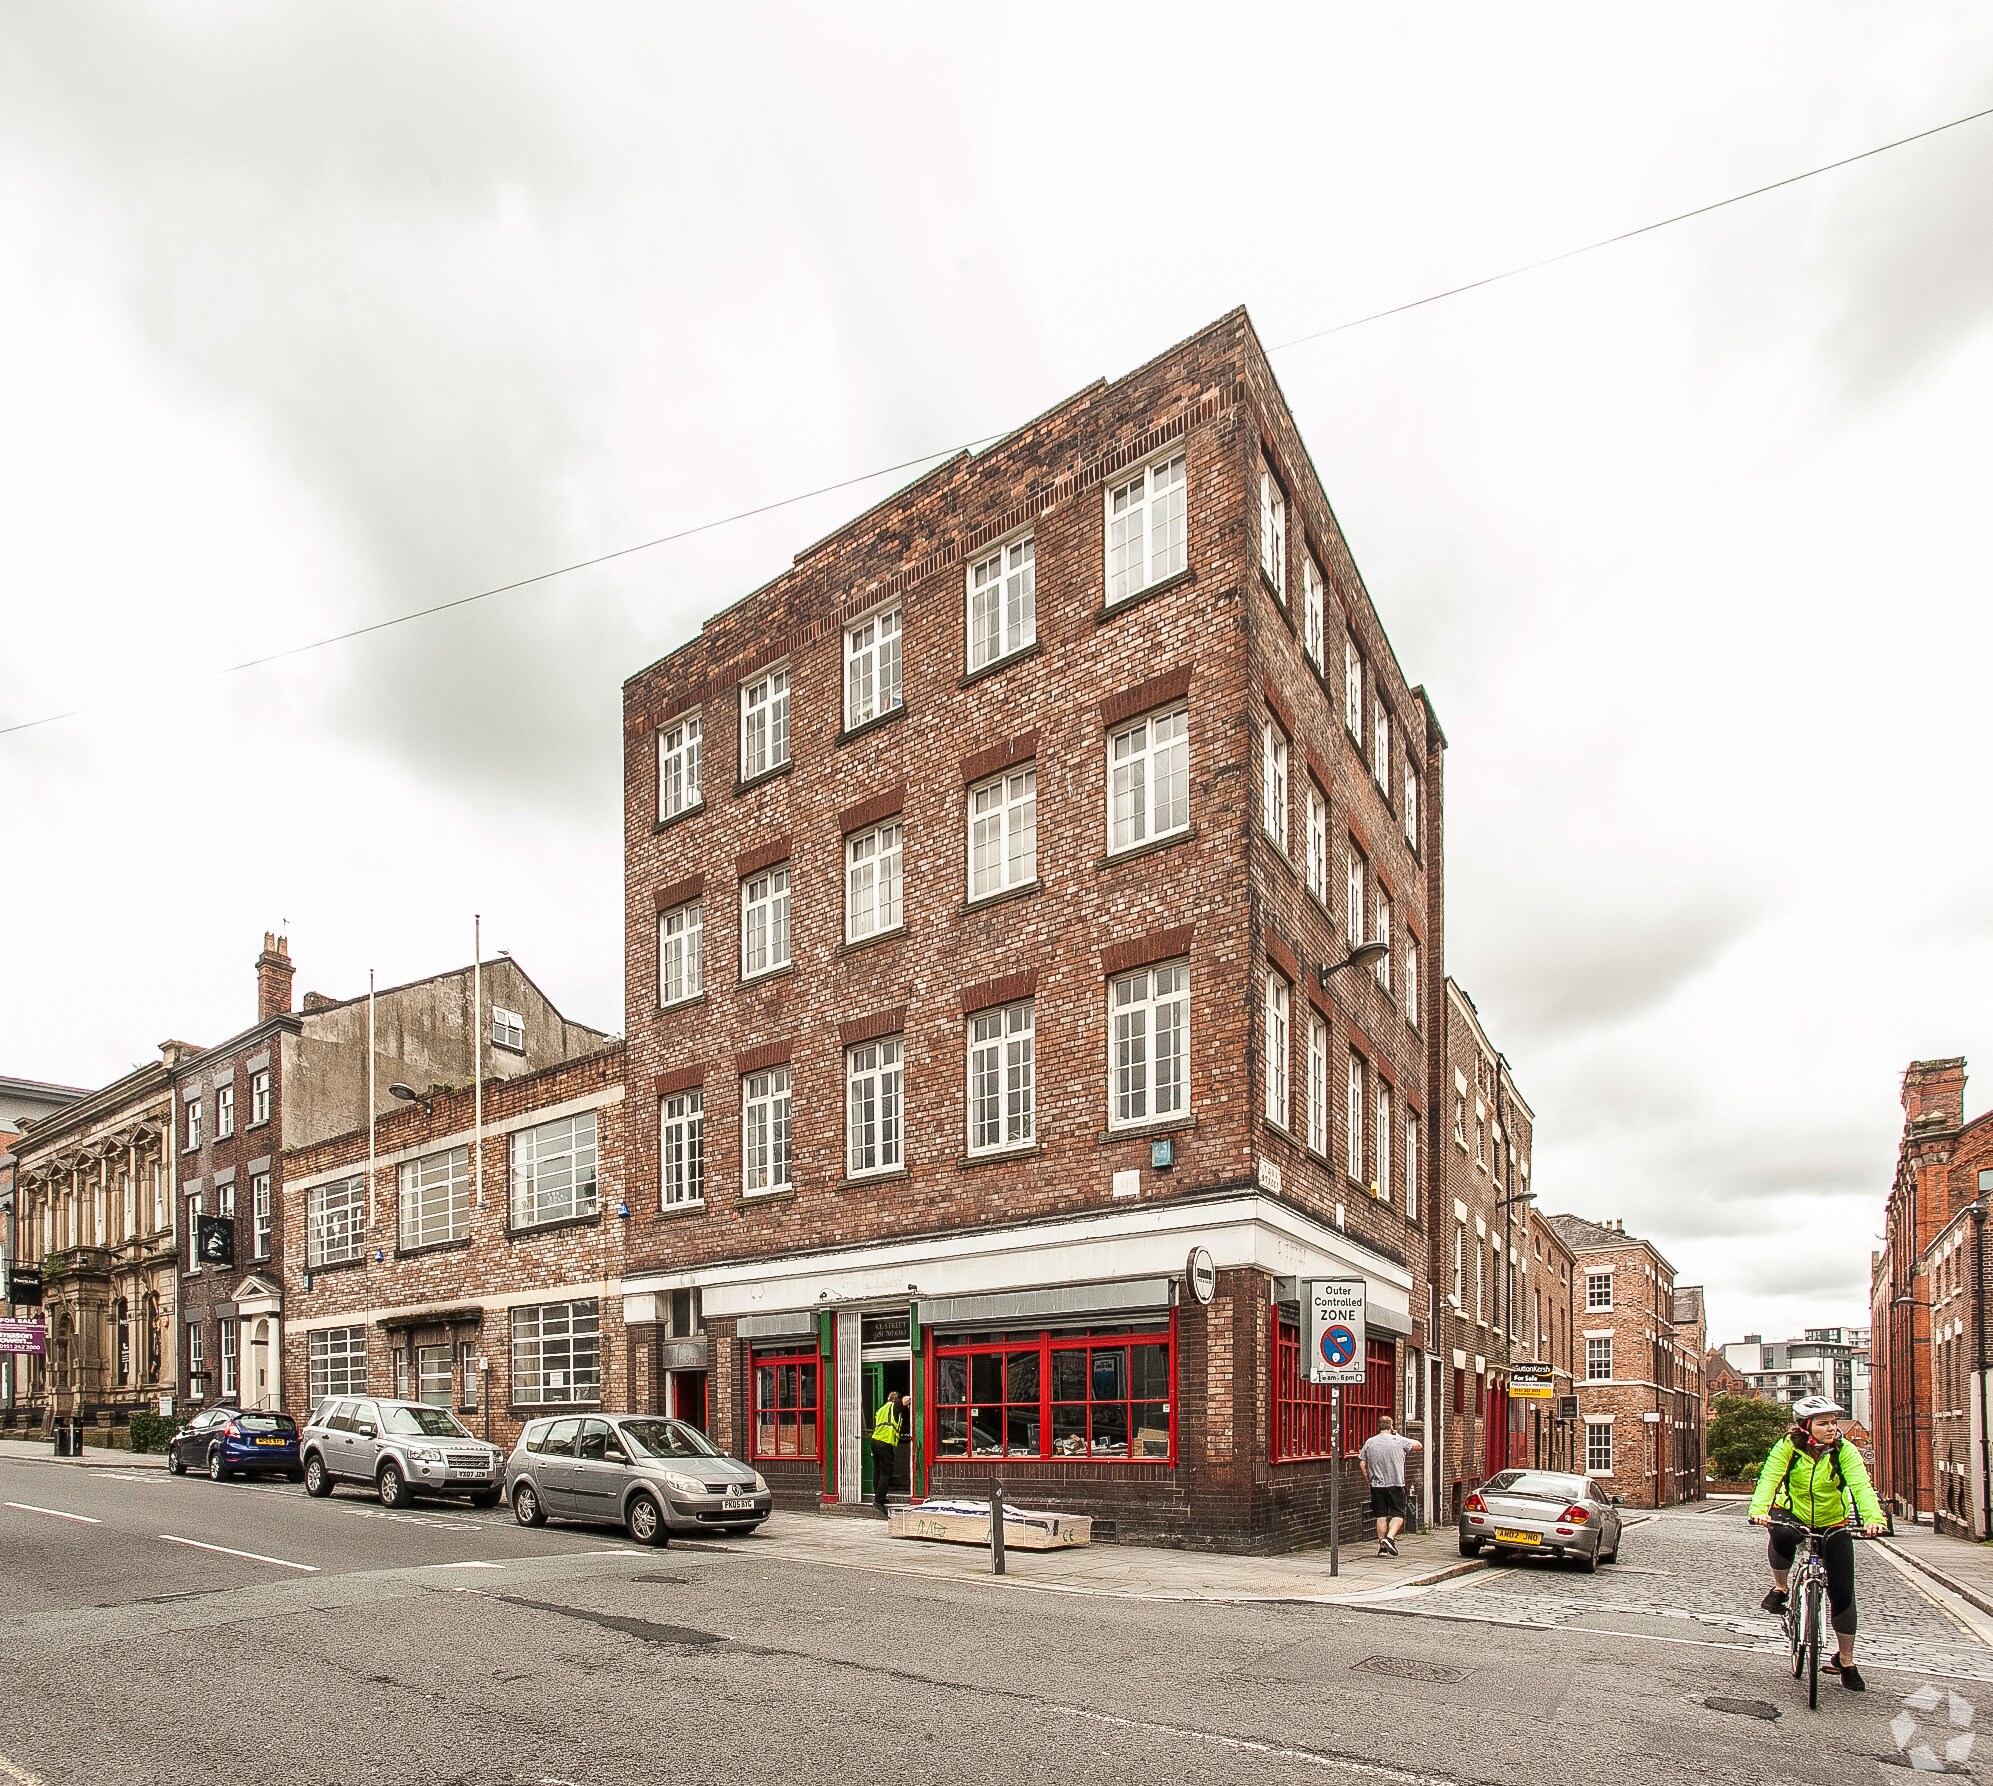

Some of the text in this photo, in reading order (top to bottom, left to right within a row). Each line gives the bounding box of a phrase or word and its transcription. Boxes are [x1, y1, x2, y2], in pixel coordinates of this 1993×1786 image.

[1325, 1286, 1351, 1295] Outer
[1314, 1297, 1362, 1307] Controlled
[1321, 1310, 1355, 1321] ZONE
[884, 1321, 908, 1330] STREET
[0, 1332, 33, 1340] mason
